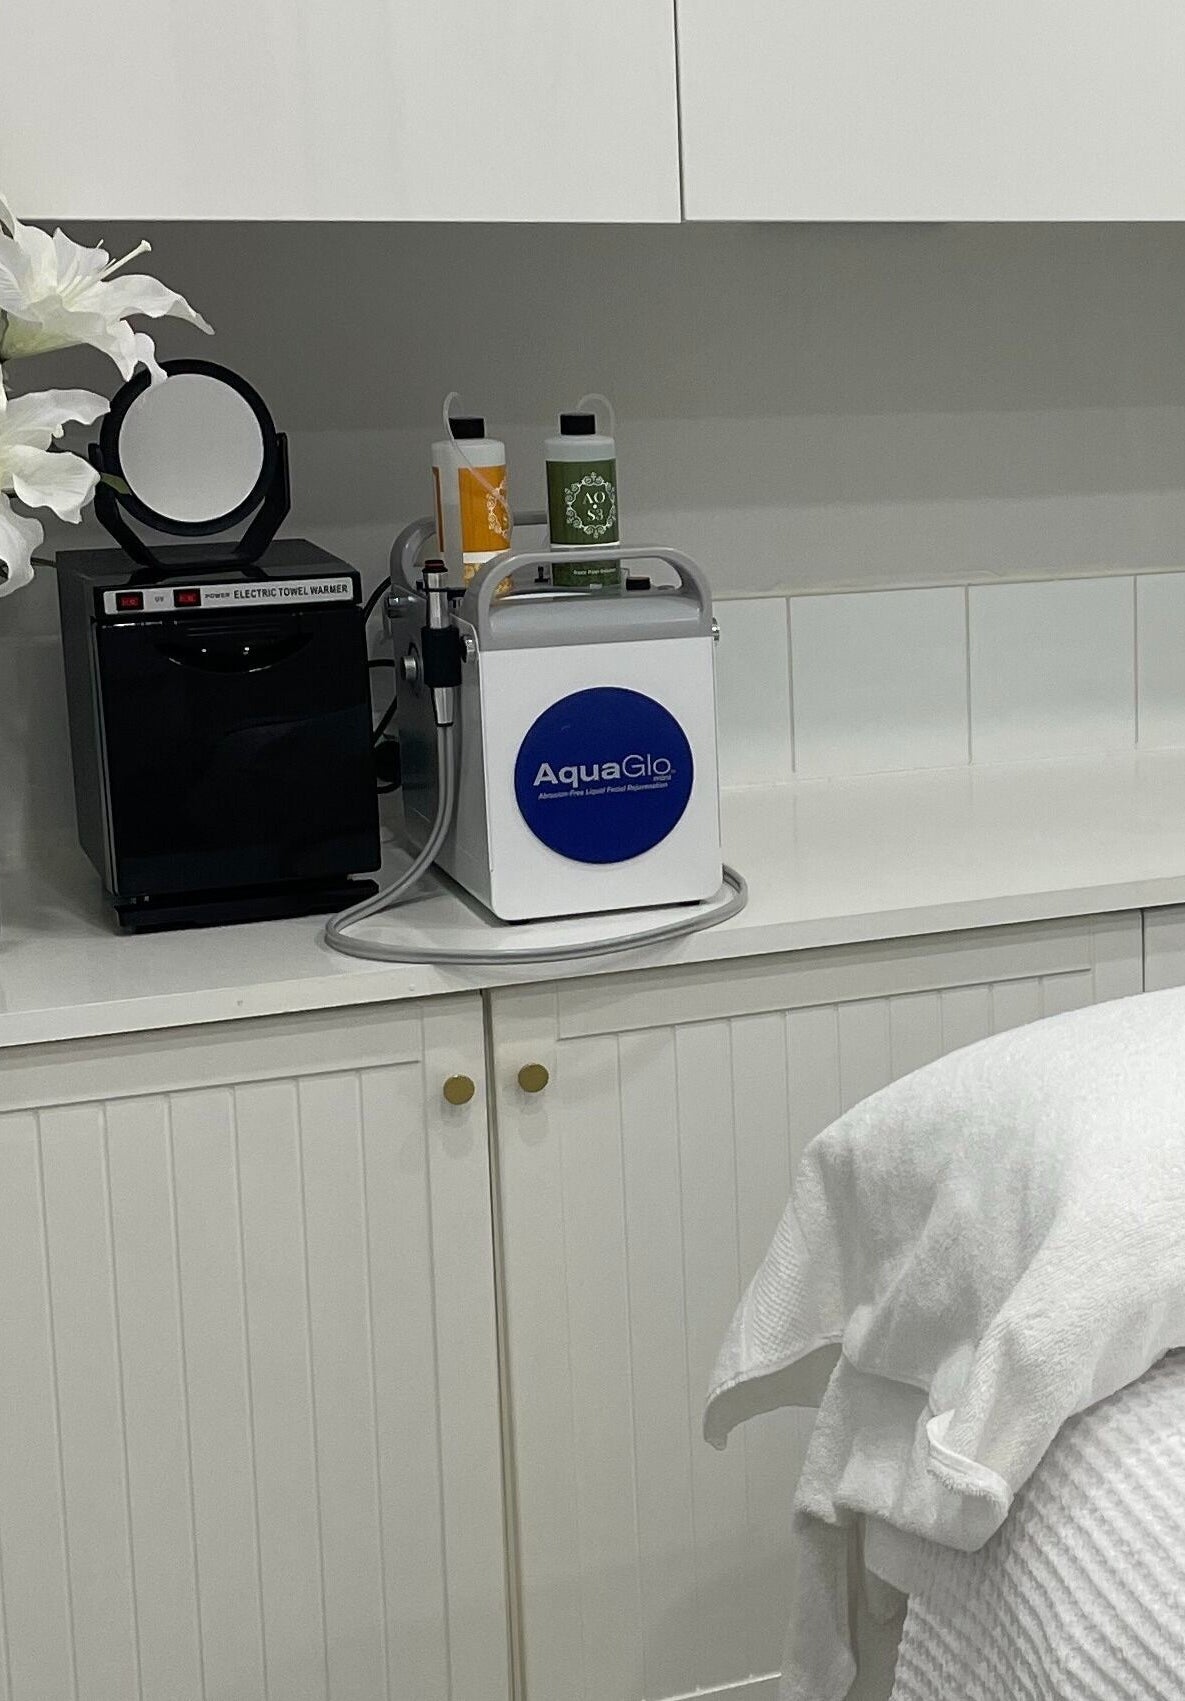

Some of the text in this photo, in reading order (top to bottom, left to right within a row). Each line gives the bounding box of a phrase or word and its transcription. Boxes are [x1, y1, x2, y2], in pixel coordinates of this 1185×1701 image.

[233, 584, 348, 599] ELECTRIC TOWEL WARMER
[533, 753, 672, 788] AquaGlo
